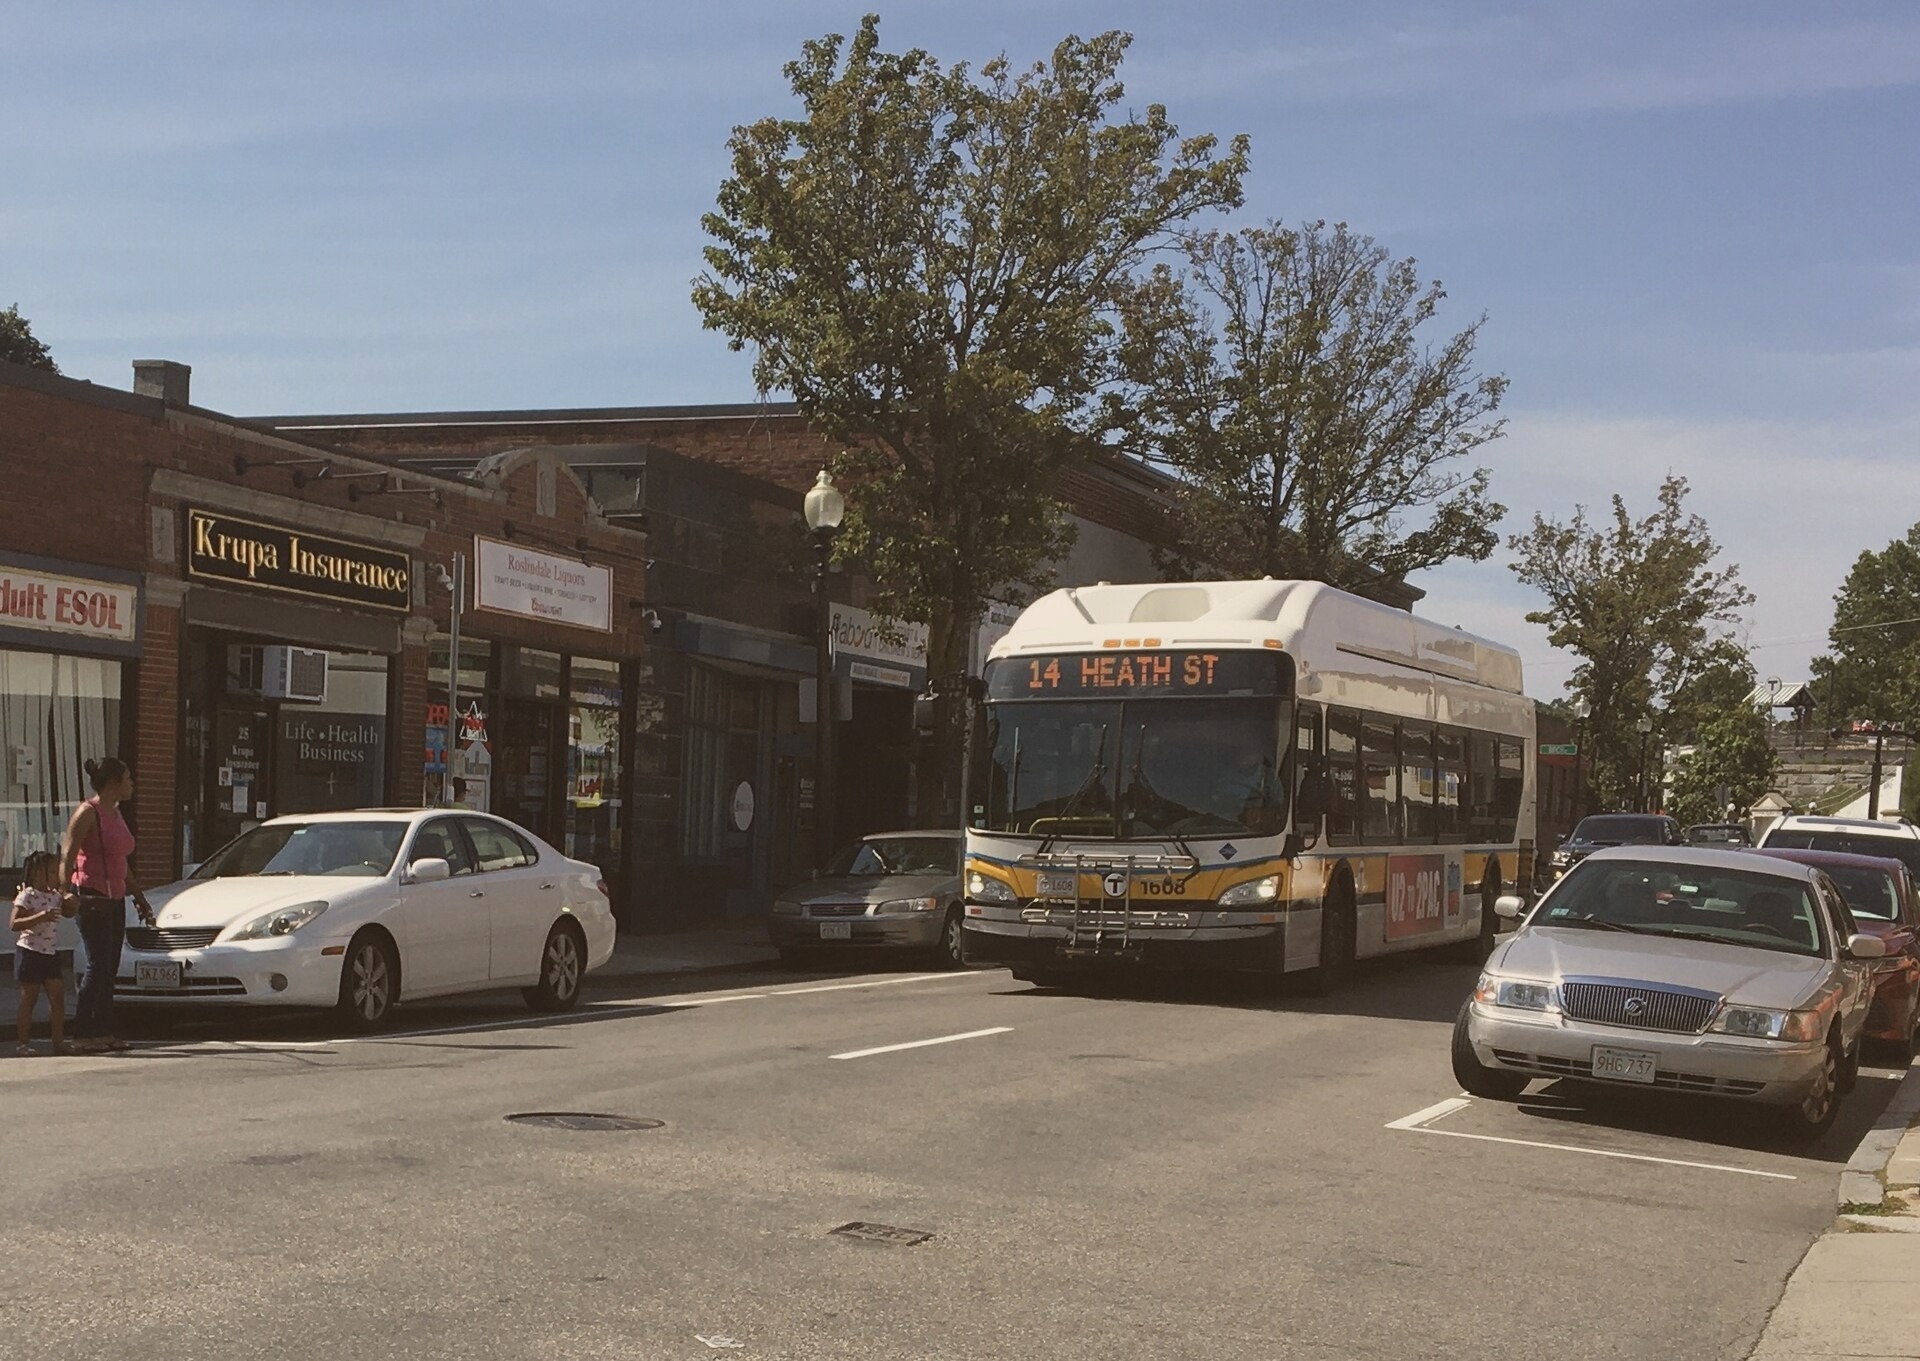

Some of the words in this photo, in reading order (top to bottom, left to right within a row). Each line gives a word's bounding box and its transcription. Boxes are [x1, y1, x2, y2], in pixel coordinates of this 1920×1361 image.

[194, 516, 280, 578] Krupa
[288, 536, 408, 593] Insurance
[508, 554, 551, 579] Roslindale
[554, 565, 586, 587] Liquors
[55, 586, 122, 631] ESOL
[1028, 657, 1062, 689] 14
[1081, 656, 1171, 687] HEATH
[1183, 655, 1219, 685] ST
[285, 721, 315, 741] Life
[328, 724, 379, 745] Health
[299, 743, 365, 763] Business
[1107, 878, 1124, 894] T
[1140, 880, 1186, 895] 1608
[1392, 872, 1405, 923] U2
[1416, 869, 1440, 920] 2PAC
